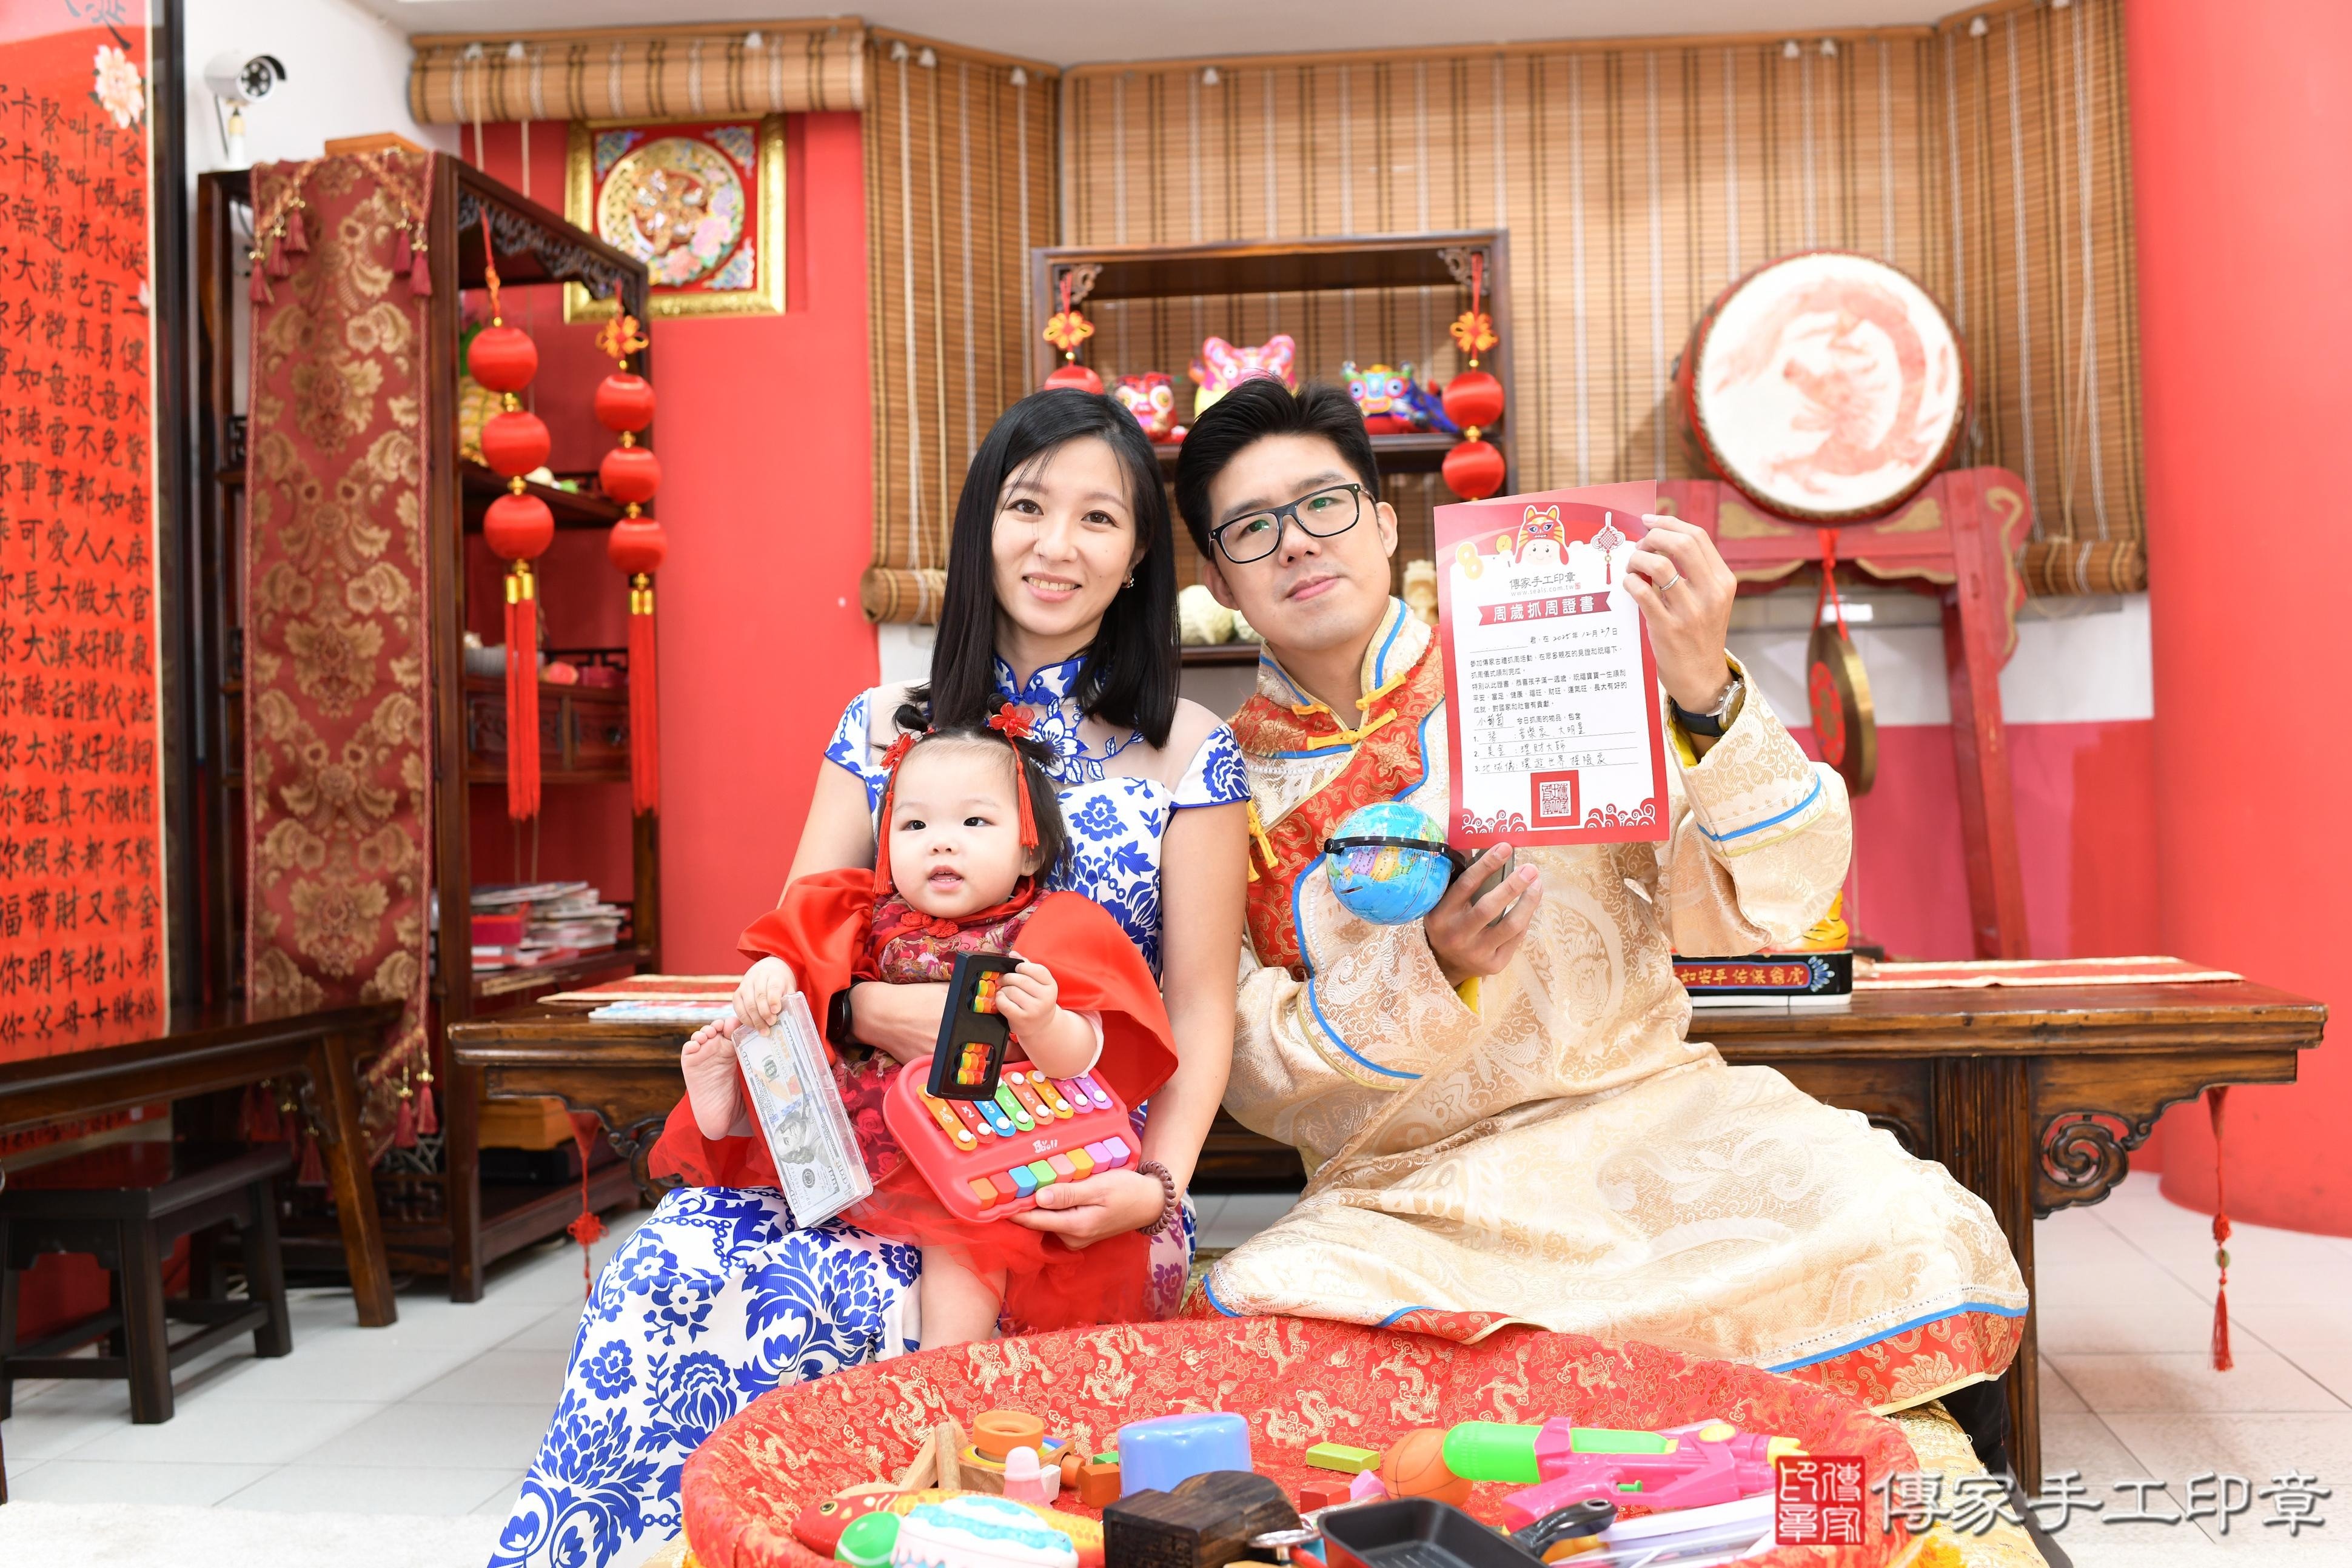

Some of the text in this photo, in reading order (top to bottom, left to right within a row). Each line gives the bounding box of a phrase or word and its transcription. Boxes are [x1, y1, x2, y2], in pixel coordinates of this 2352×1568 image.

[1509, 572, 1576, 590] 傳家手工印章
[1512, 585, 1574, 597] www.seals.com.tw
[1494, 595, 1594, 623] 周歲抓周證書
